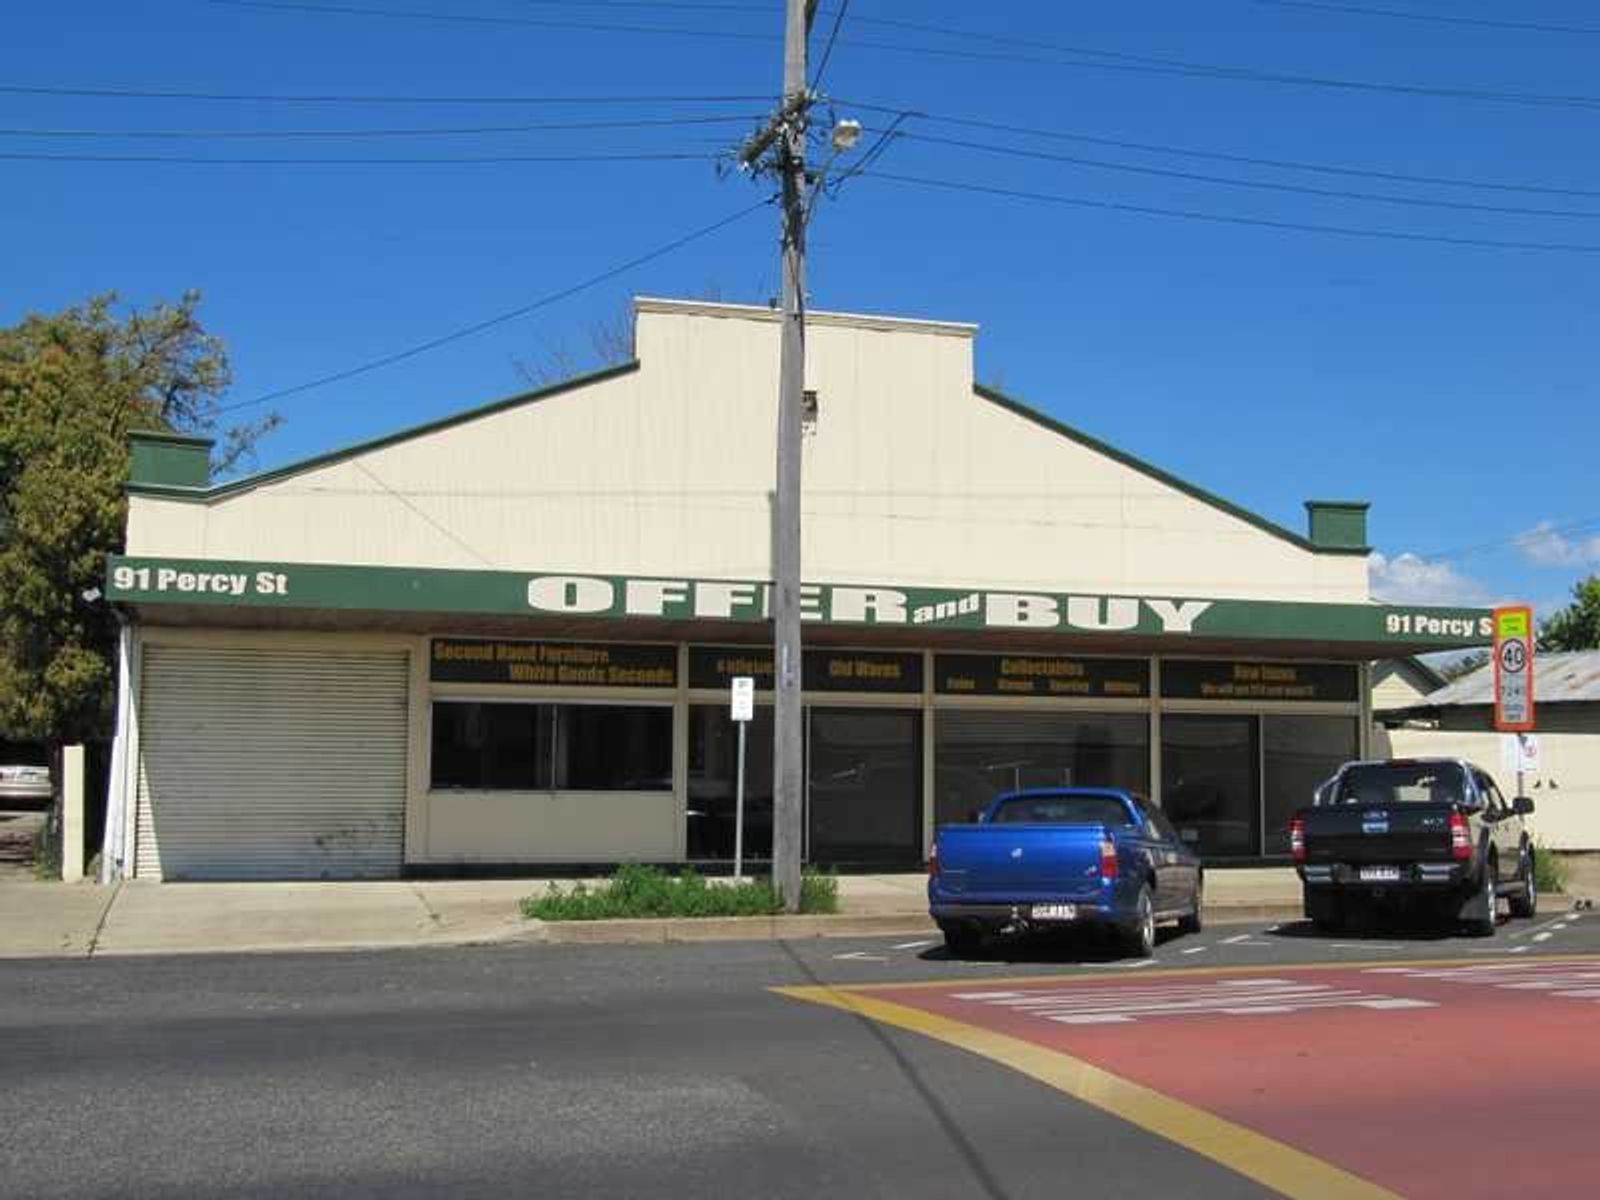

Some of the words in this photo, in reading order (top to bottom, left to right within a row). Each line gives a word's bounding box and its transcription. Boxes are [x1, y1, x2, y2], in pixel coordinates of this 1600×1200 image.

[113, 566, 149, 590] 91
[157, 568, 247, 595] Percy
[256, 571, 287, 594] St
[527, 576, 908, 622] OFFER
[913, 592, 979, 624] and
[985, 592, 1214, 633] BUY
[1386, 614, 1410, 633] 91
[1414, 615, 1475, 637] Percy
[1478, 617, 1494, 635] S
[434, 642, 491, 661] Second
[1503, 646, 1524, 665] 40
